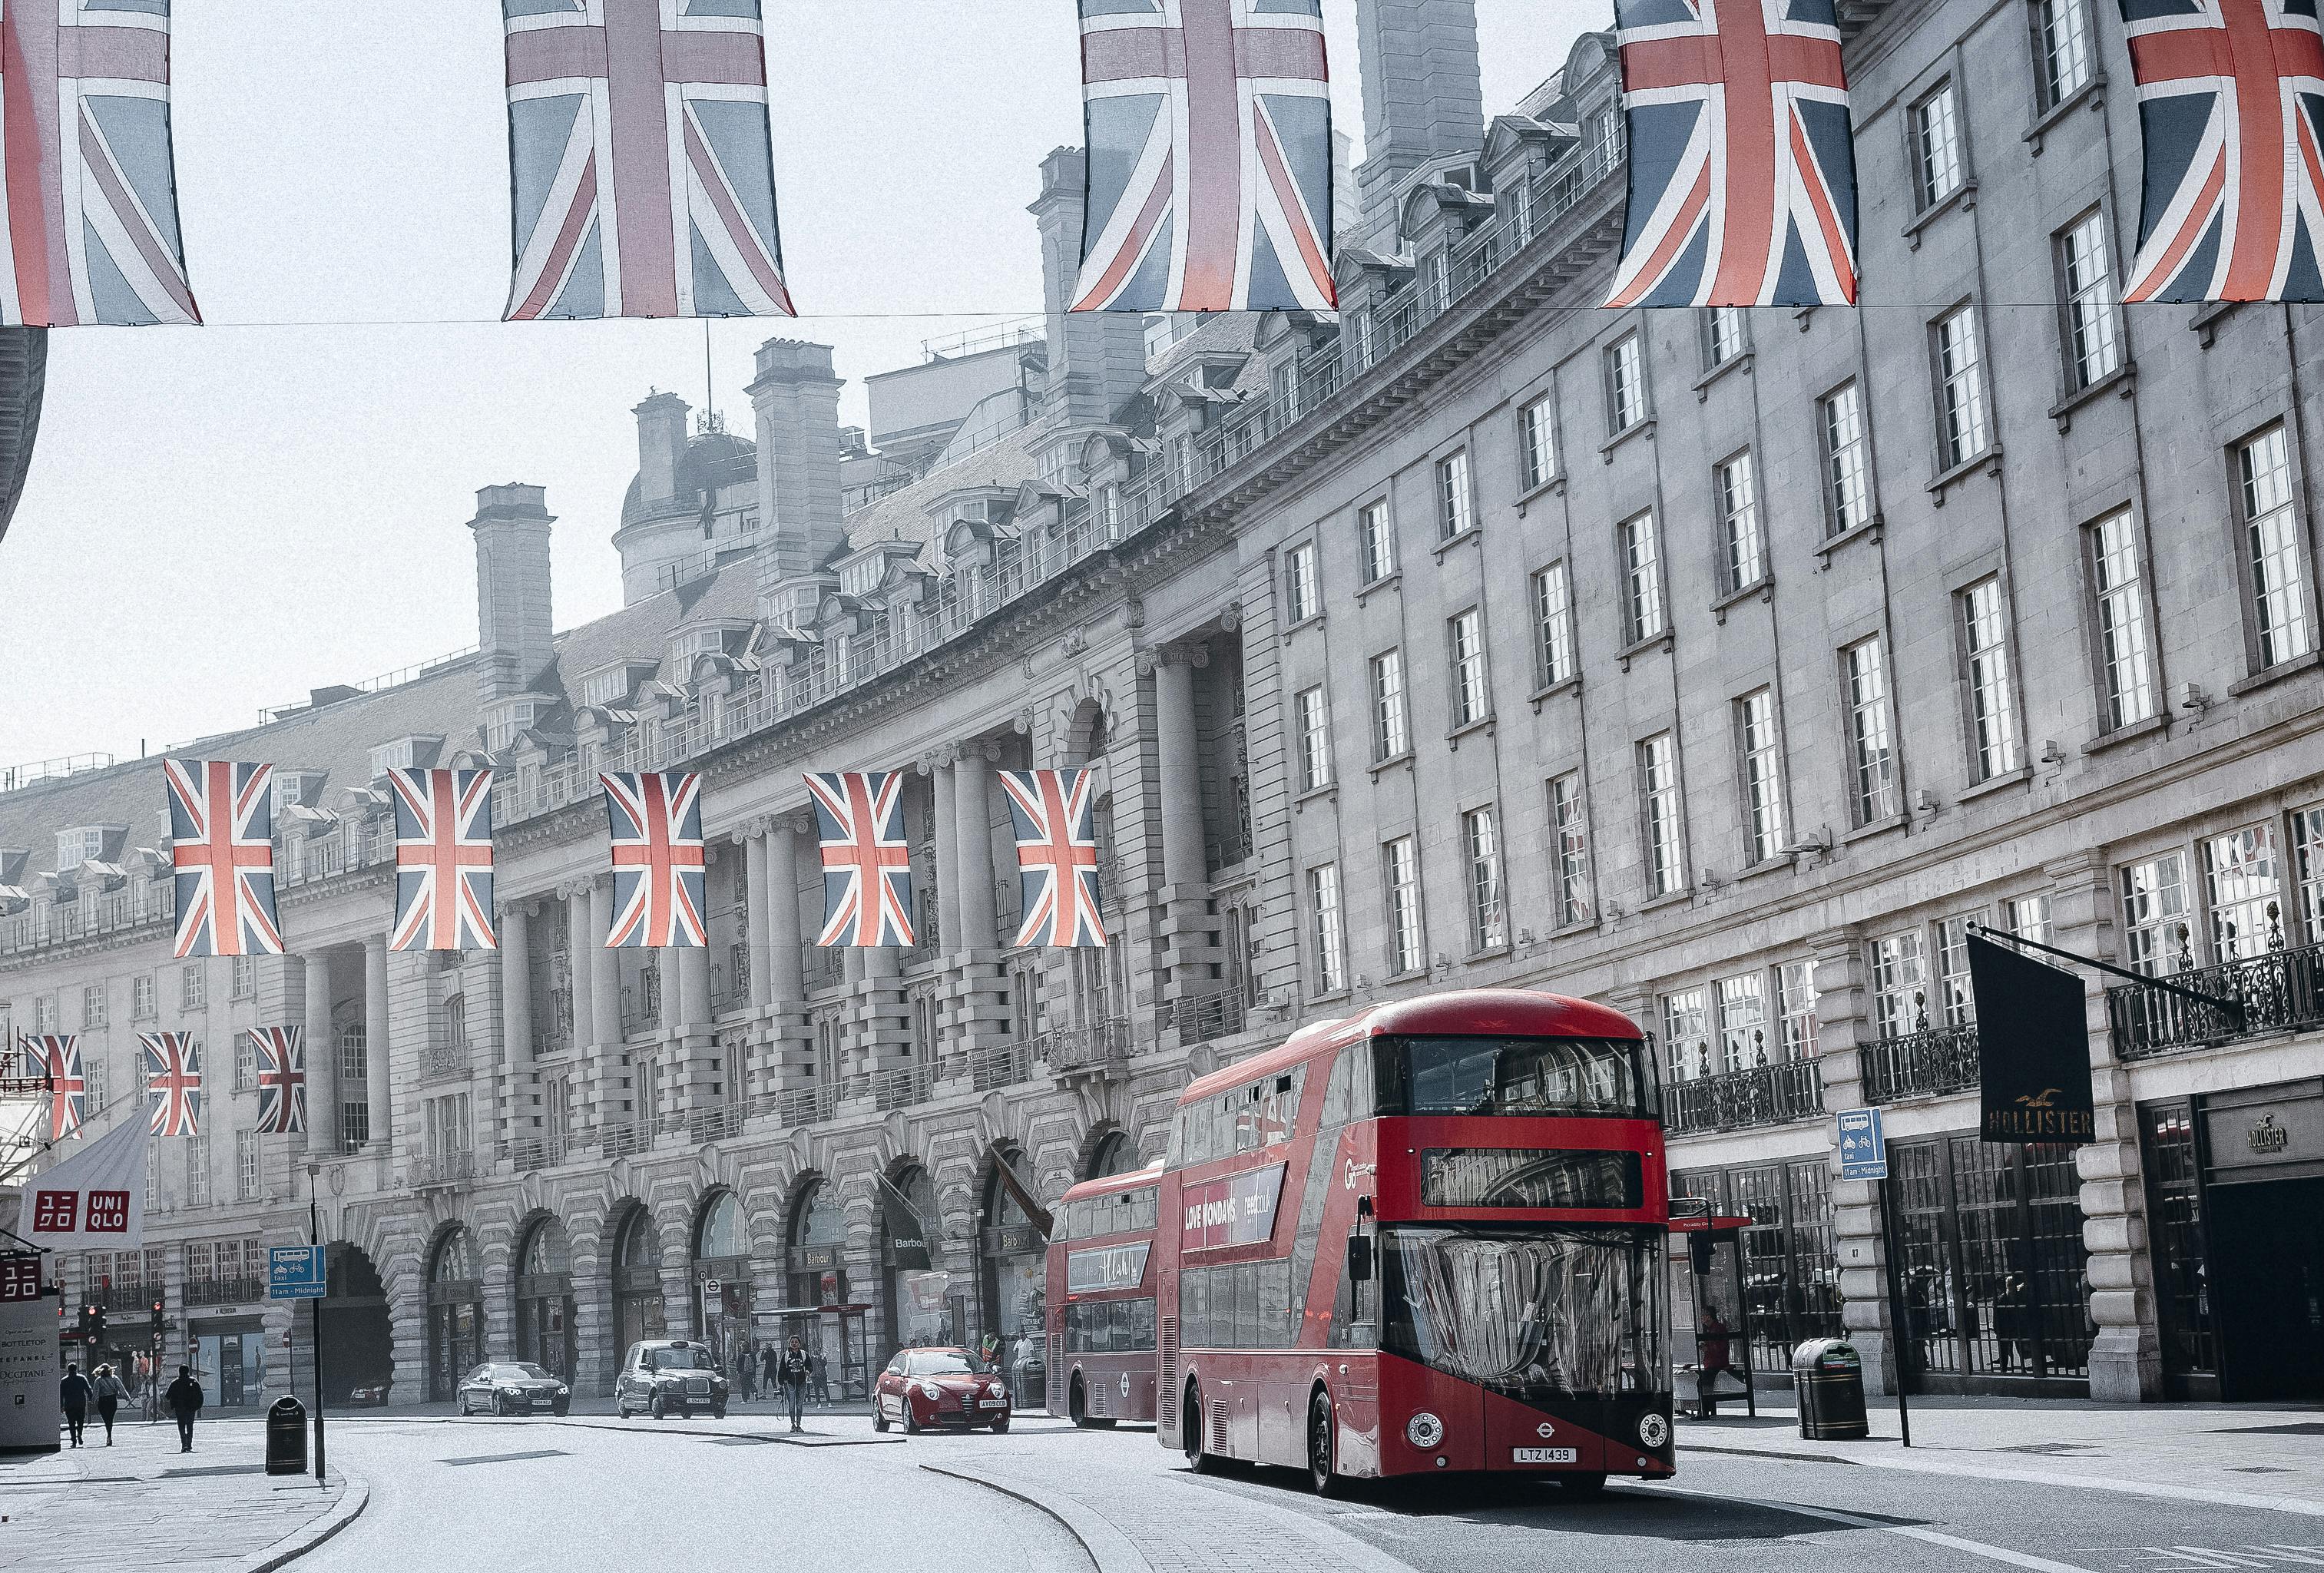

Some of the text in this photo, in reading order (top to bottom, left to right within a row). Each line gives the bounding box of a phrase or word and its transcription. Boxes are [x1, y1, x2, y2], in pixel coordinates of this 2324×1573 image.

[1989, 1110, 2091, 1134] HOLLISTER
[2247, 1128, 2285, 1147] HOLLISTER
[1861, 1166, 1885, 1175] Midnight
[92, 1196, 121, 1210] UNI
[91, 1213, 124, 1229] QLO
[1185, 1204, 1202, 1230] LOVE
[896, 1238, 926, 1248] Barbou
[1002, 1234, 1028, 1247] Barbour
[807, 1253, 829, 1264] Barbour
[1, 1339, 46, 1347] BOTTLETOP
[1521, 1449, 1569, 1461] LTZ 1439
